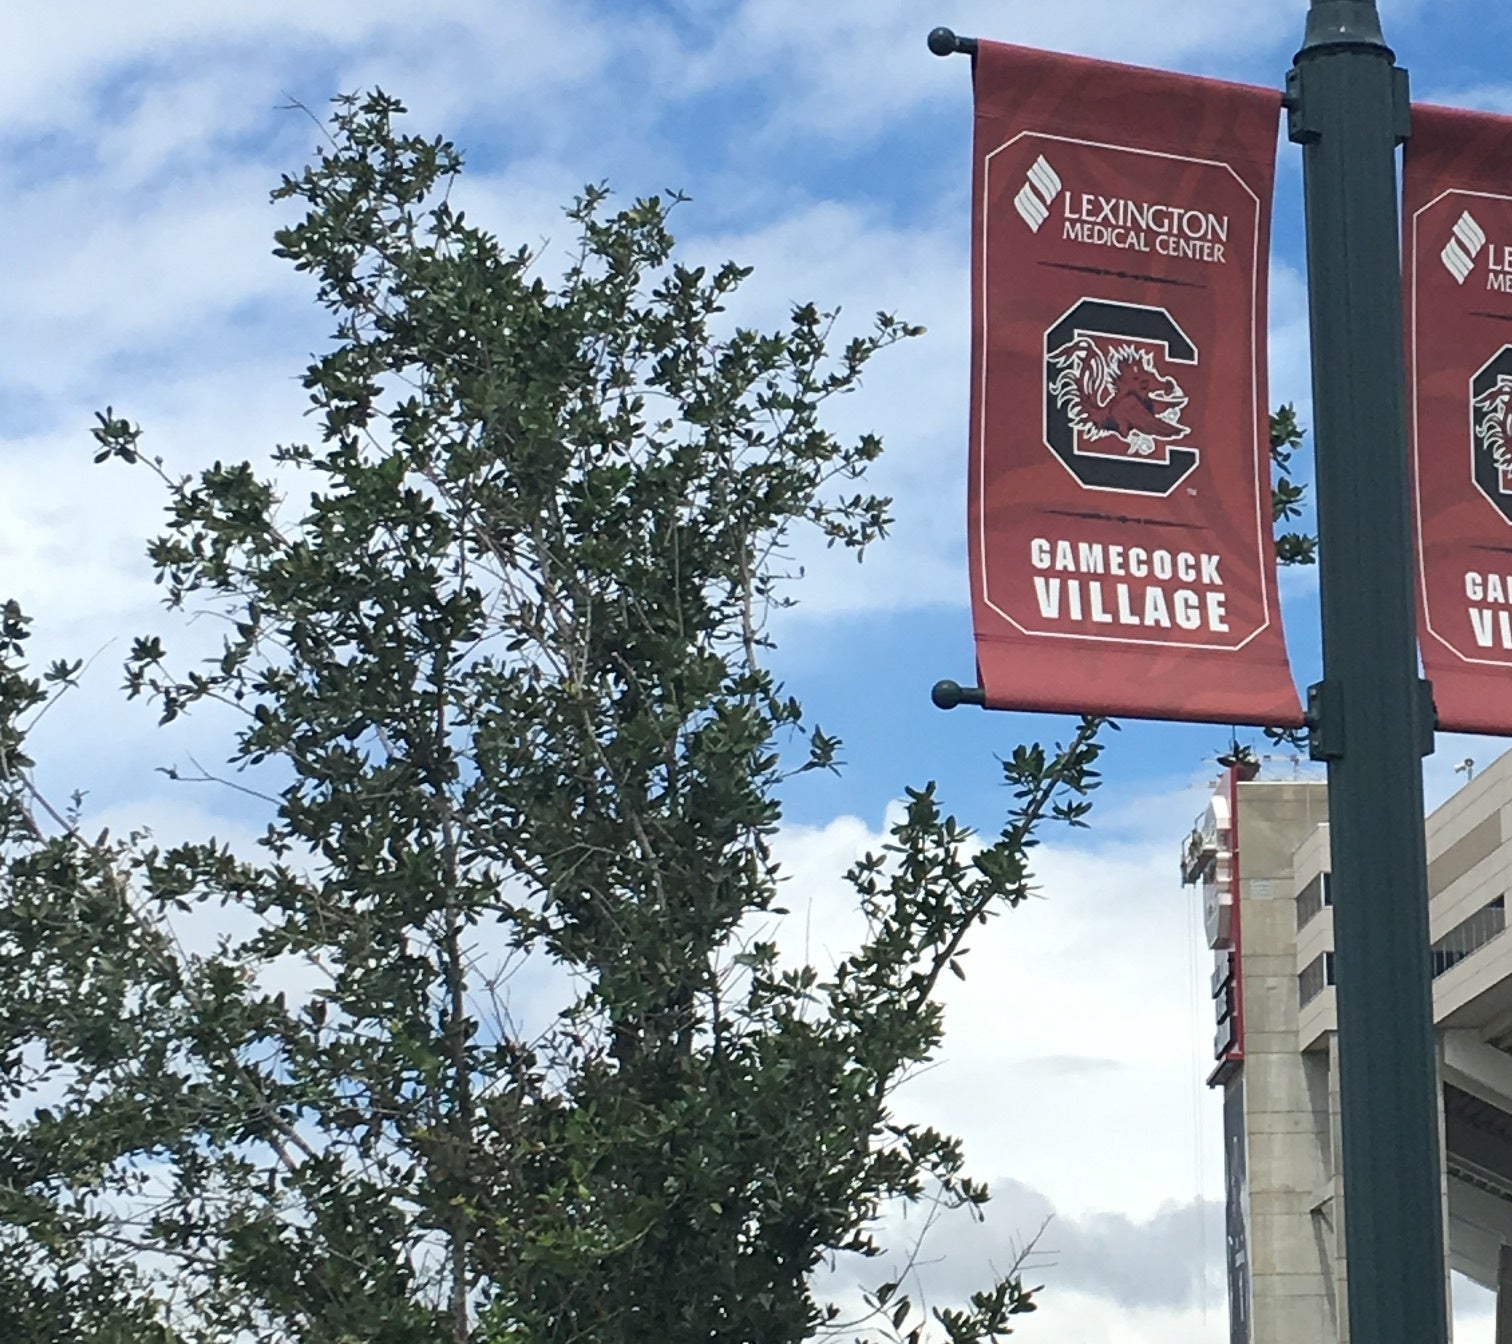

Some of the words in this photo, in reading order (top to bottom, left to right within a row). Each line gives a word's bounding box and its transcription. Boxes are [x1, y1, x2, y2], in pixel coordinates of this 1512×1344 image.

[1064, 191, 1228, 242] LEXINGTON
[1062, 221, 1150, 252] MEDICAL
[1155, 235, 1226, 264] CENTER
[1030, 537, 1224, 586] GAMECOCK
[1033, 576, 1230, 633] VILLAGE
